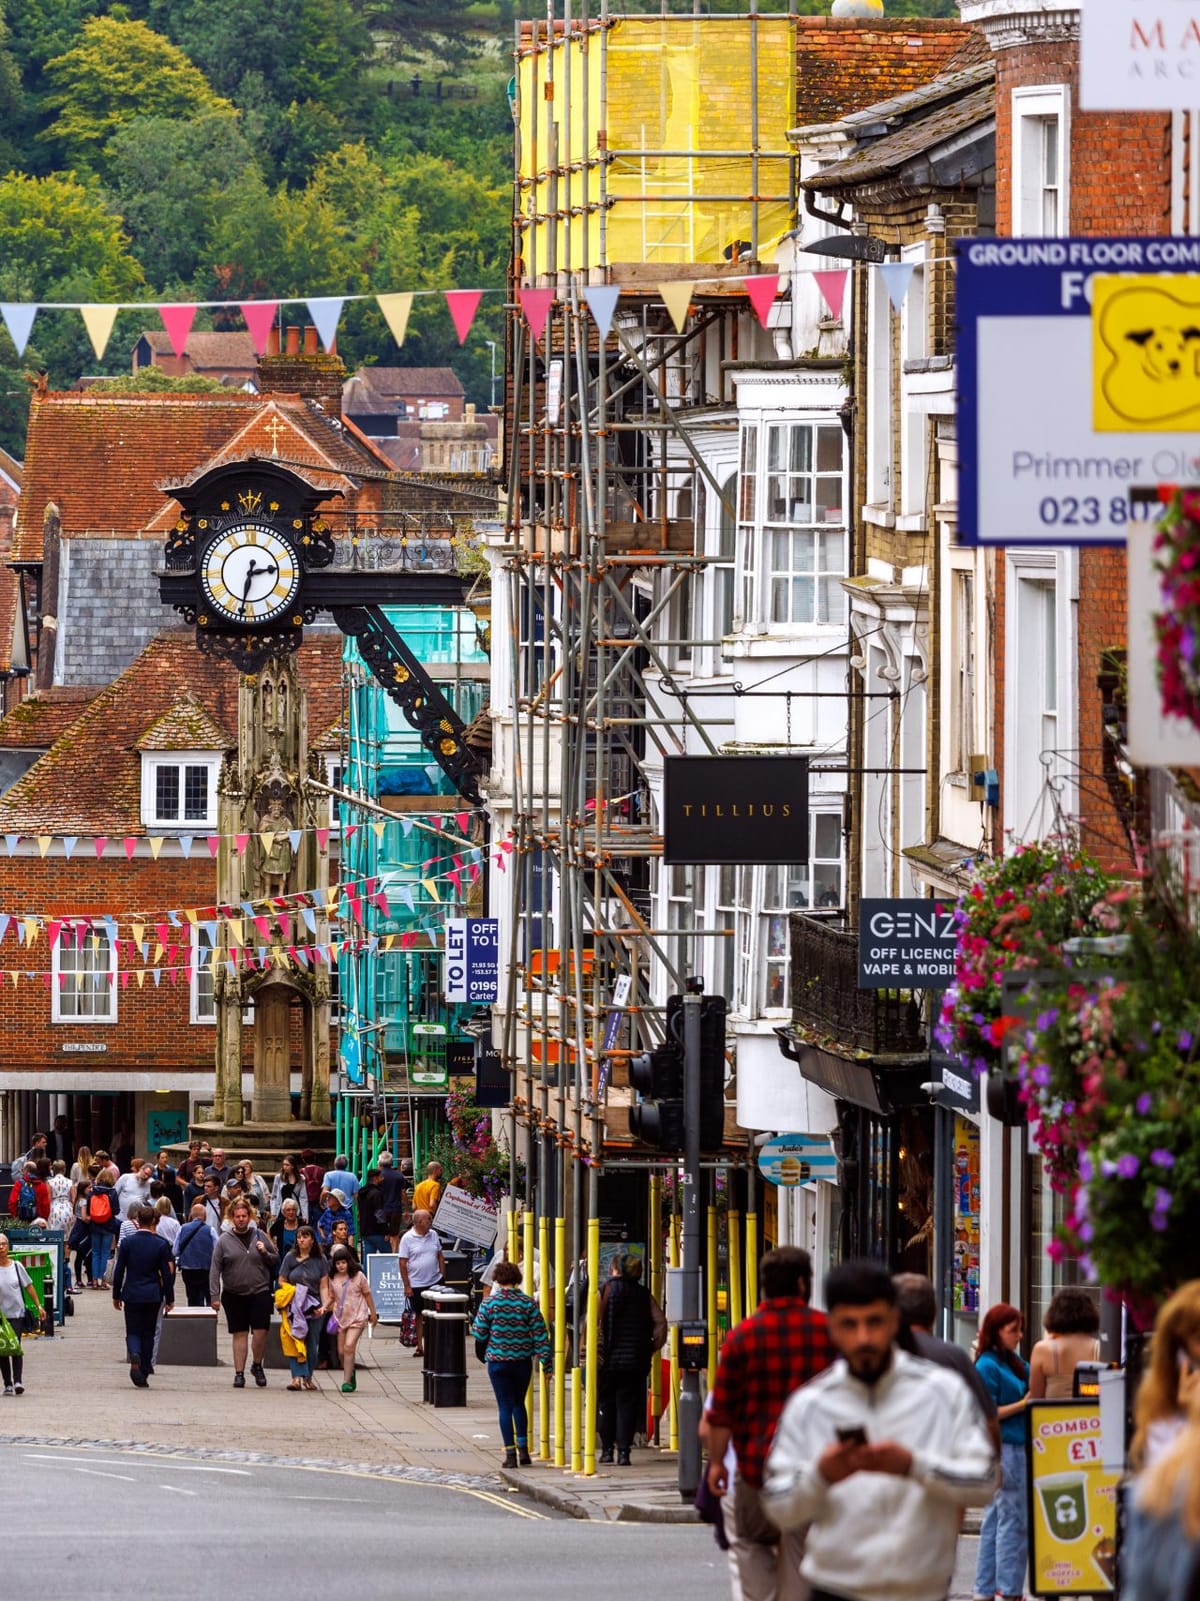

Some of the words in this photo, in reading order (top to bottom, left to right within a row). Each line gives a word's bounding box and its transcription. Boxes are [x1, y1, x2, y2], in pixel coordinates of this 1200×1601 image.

[969, 244, 1066, 265] GROUND
[1069, 244, 1141, 264] FLOOR
[1012, 451, 1142, 478] Primmer
[1039, 496, 1100, 525] 023
[683, 803, 791, 817] TILLIUS
[869, 911, 959, 939] GENZ
[448, 926, 464, 961] LET
[471, 935, 489, 946] TO
[870, 948, 898, 959] OFF
[901, 948, 960, 960] LICENCE
[863, 963, 900, 975] VAPE
[903, 963, 913, 975] &
[917, 963, 958, 975] MOBIL
[448, 966, 464, 993] TO
[470, 981, 497, 991] 0196
[469, 991, 495, 1000] Carter
[485, 1050, 501, 1058] MO
[379, 1280, 404, 1289] STYL
[1040, 1418, 1101, 1436] COMBO
[1071, 1440, 1098, 1461] £1
